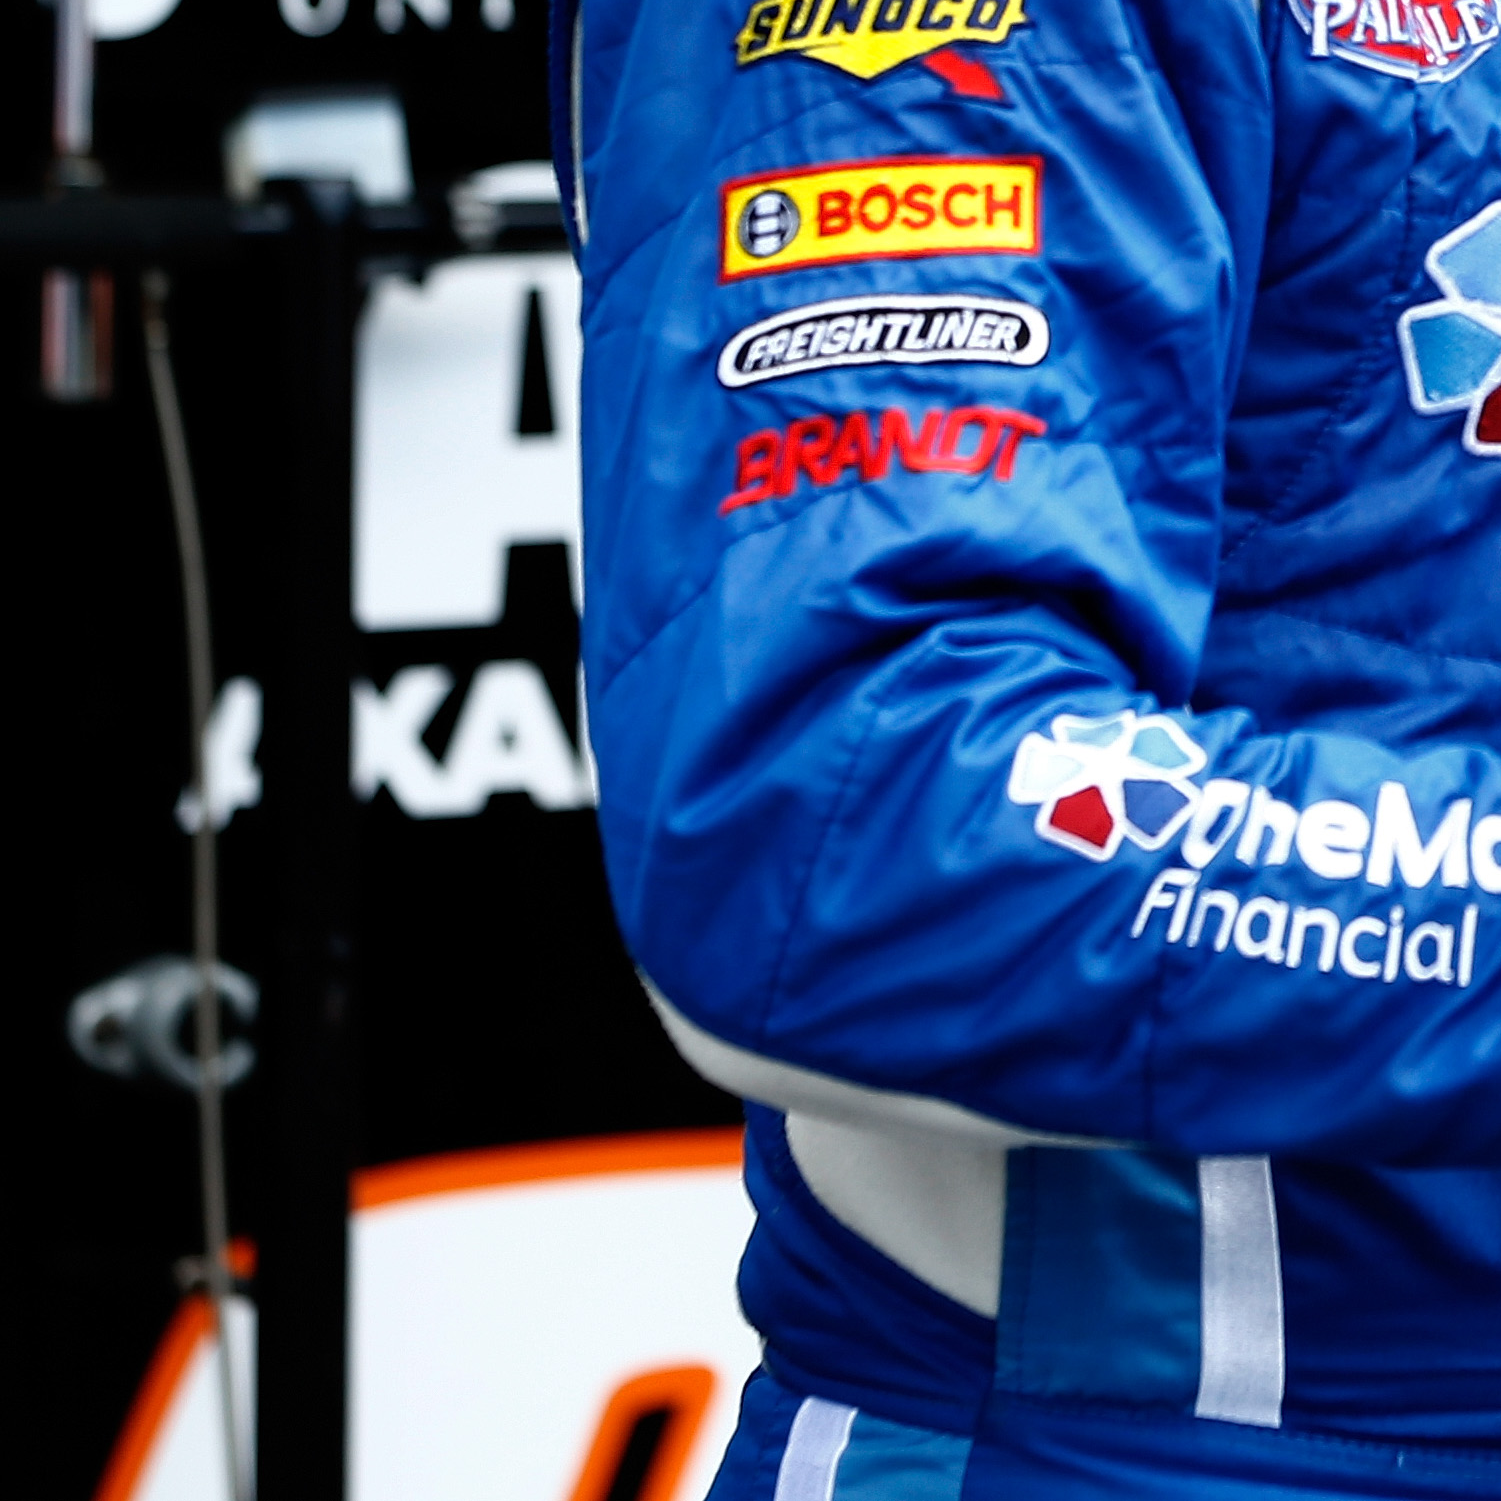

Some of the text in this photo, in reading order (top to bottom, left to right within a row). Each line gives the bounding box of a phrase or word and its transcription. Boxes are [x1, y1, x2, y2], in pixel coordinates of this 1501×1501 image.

[817, 182, 1022, 237] BOSCH
[742, 310, 1022, 372] FREIGHTLINER
[718, 405, 1047, 517] BRANDT
[1131, 866, 1479, 988] Financial
